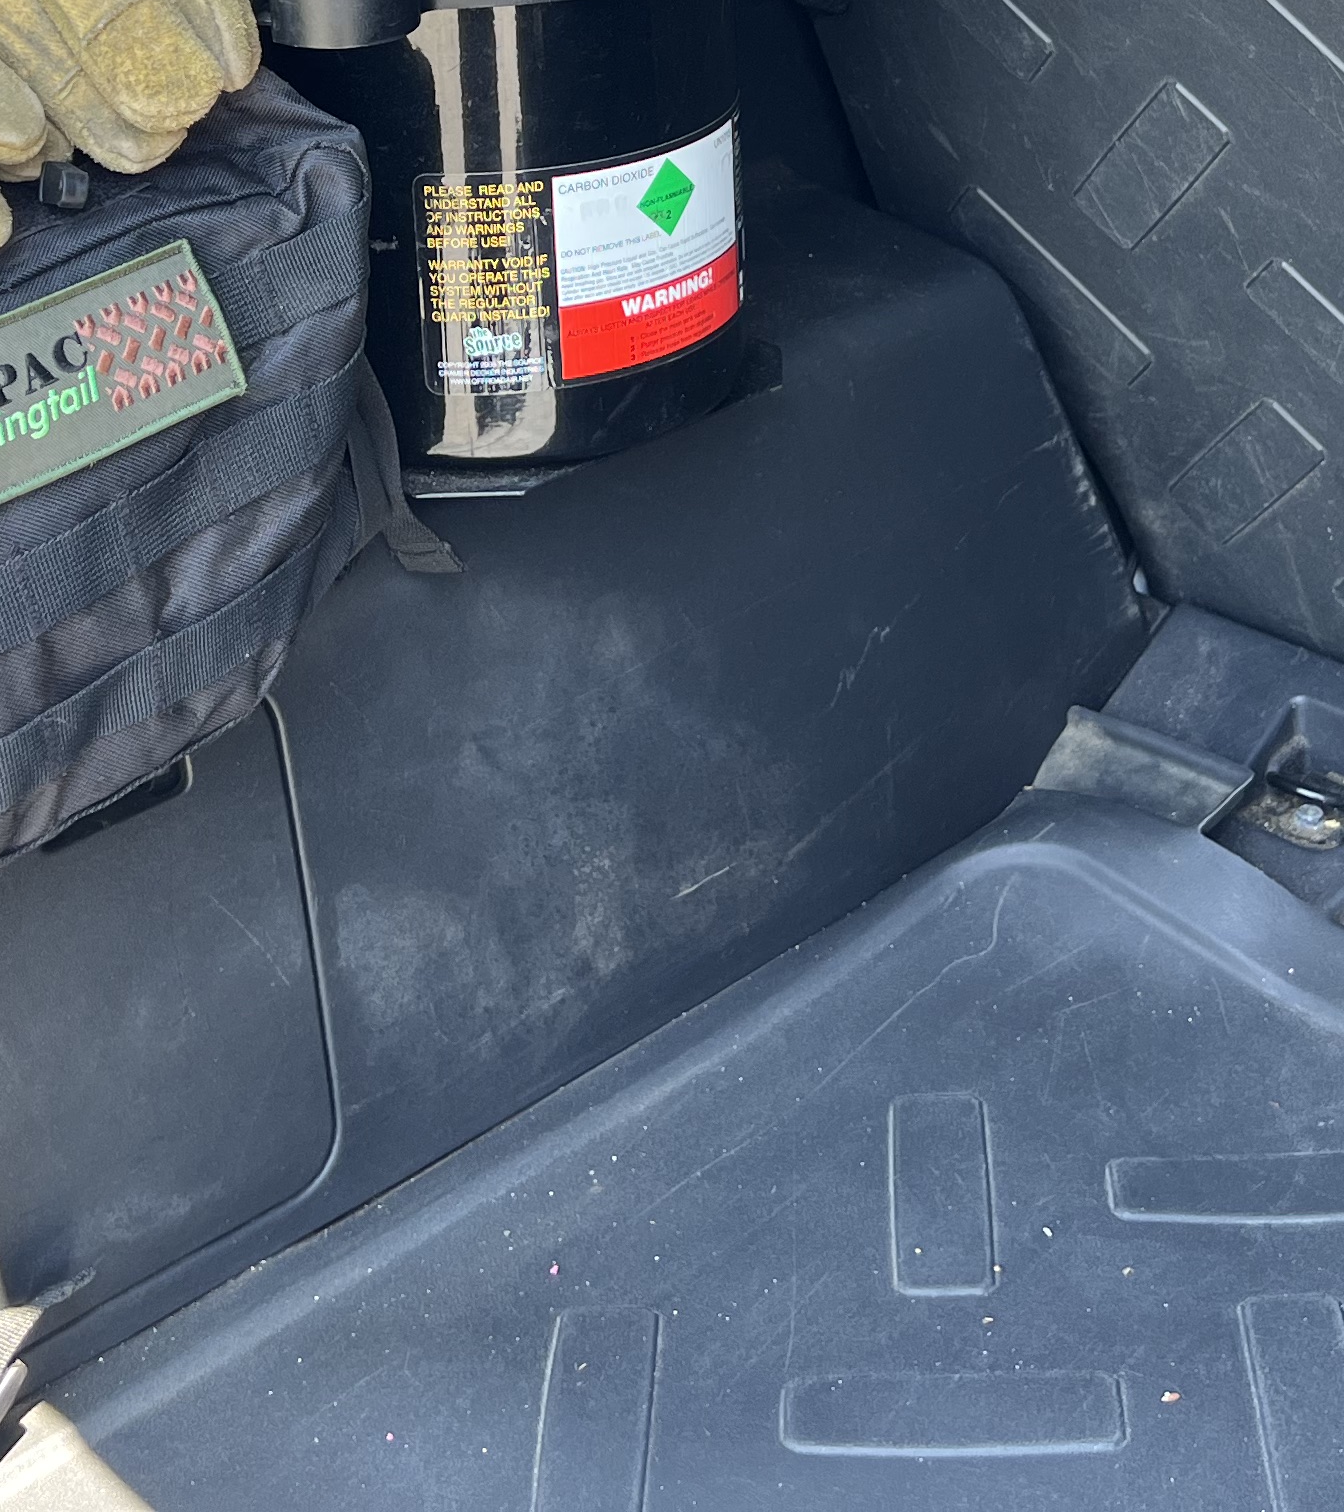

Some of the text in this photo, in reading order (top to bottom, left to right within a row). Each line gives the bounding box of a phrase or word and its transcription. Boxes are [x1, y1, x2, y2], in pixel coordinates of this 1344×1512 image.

[423, 180, 544, 197] PLEASE READ AND
[558, 166, 655, 195] CARBON DIOXIDE
[424, 195, 536, 210] UNDERSTAND ALL
[426, 207, 540, 223] OF INSTRUCTIONS
[666, 210, 672, 219] 2
[426, 222, 525, 236] AND WARNINGS
[427, 236, 511, 249] BEFORE USE!
[560, 230, 661, 258] DO NOT REMOVE THIS LABEL
[428, 254, 548, 270] WARRANTY VOID IF
[429, 267, 550, 284] YOU OPERATE THIS
[430, 285, 482, 297] SYSTEM
[484, 281, 544, 296] WITHOUT
[621, 267, 713, 317] WARNING!
[431, 295, 536, 309] THE REGULATOR
[432, 305, 550, 322] GUARD INSTALLED!
[465, 333, 520, 355] Source
